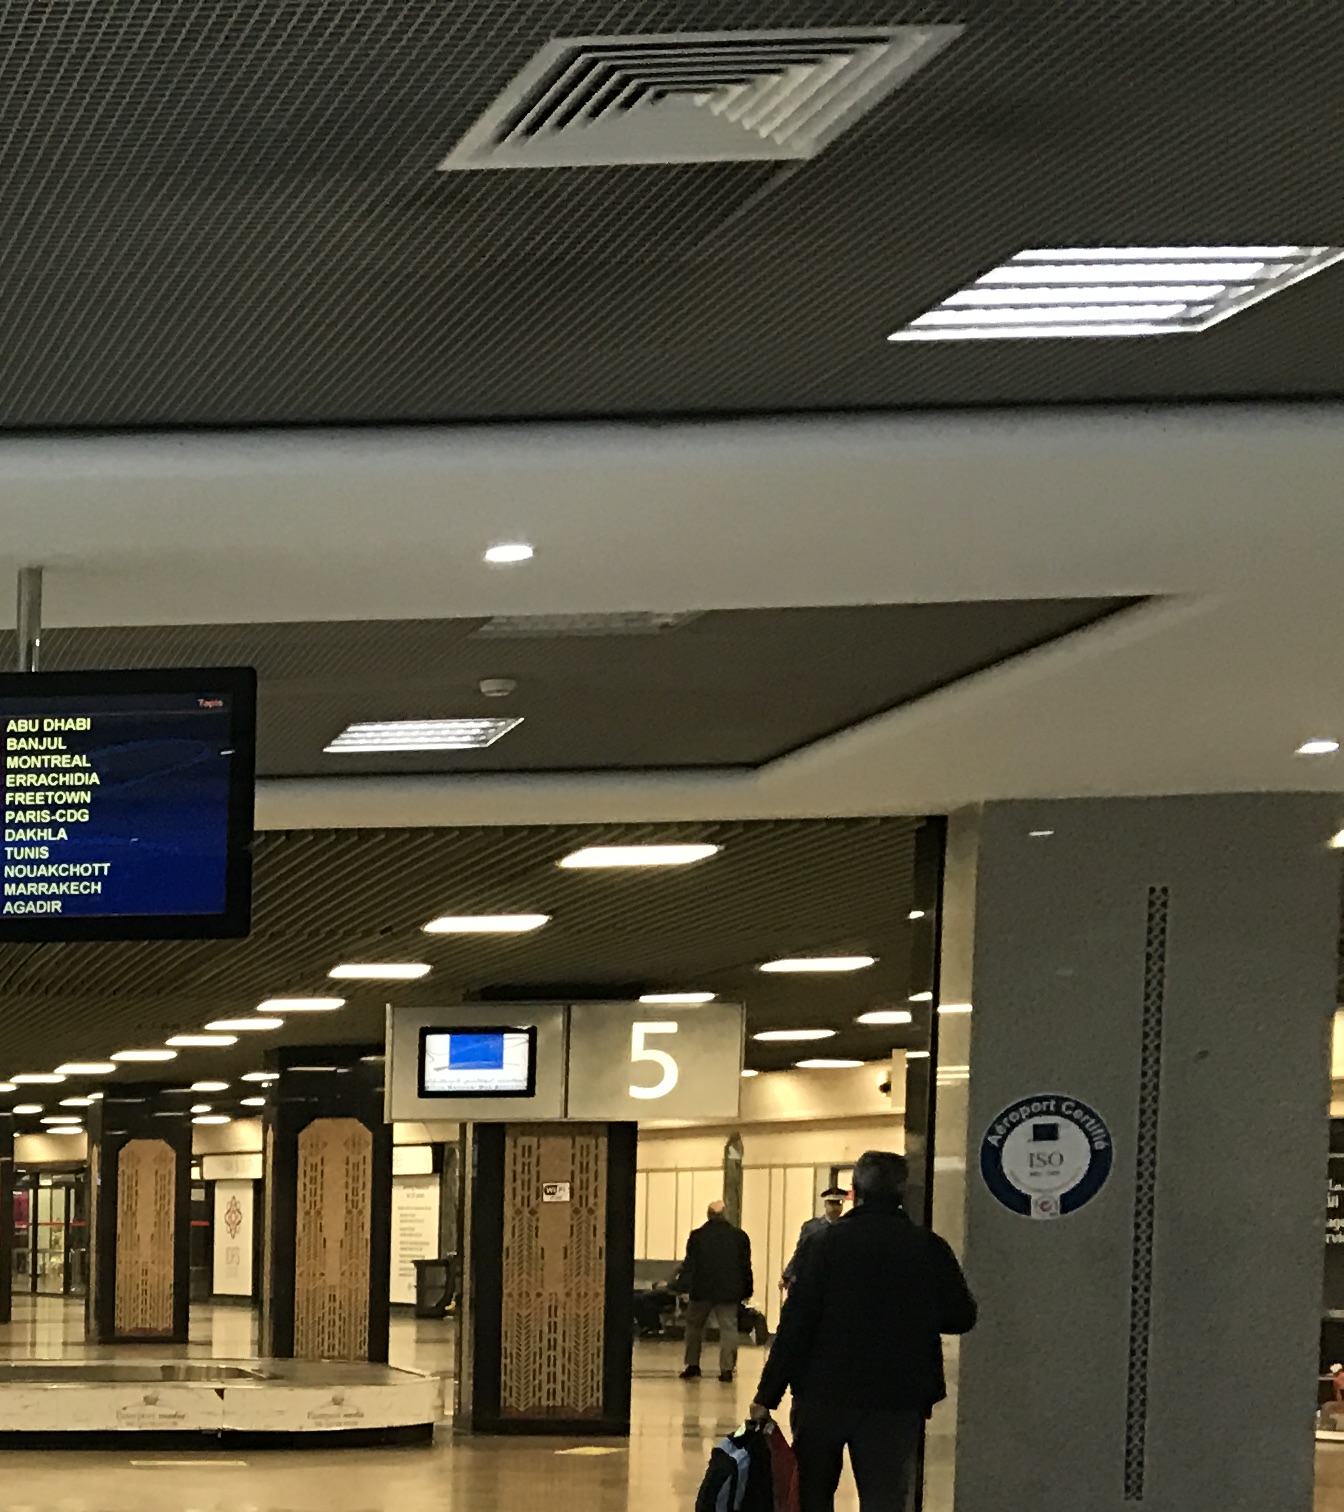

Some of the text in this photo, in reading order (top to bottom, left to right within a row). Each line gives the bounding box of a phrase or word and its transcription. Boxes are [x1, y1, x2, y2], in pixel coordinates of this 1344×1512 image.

[6, 719, 39, 733] ABU
[43, 717, 91, 732] DHABI
[6, 737, 67, 751] BANJUL
[6, 754, 91, 769] MONTREAL
[6, 772, 100, 787] ERRACHIDIA
[5, 791, 91, 805] FREETOWN
[5, 809, 90, 824] PARIS-CDG
[4, 827, 68, 842] DAKHLA
[4, 846, 49, 860] TUNIS
[4, 862, 111, 878] NOUAKCHOTT
[4, 881, 102, 896] MARRAKECH
[3, 901, 62, 914] AGADIR
[629, 1021, 679, 1099] 5
[1029, 1152, 1064, 1168] ISO
